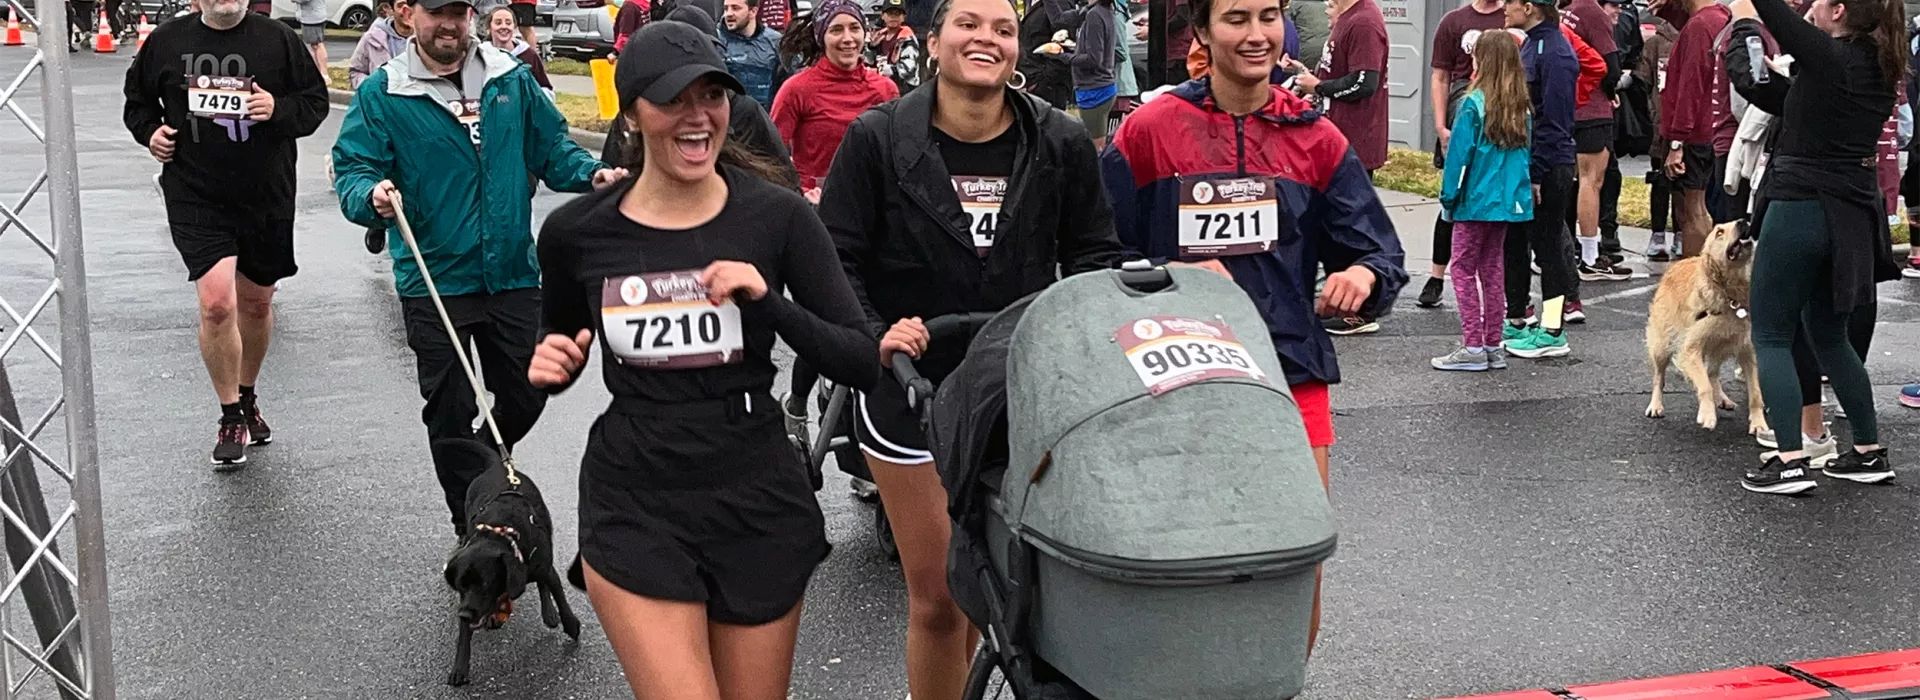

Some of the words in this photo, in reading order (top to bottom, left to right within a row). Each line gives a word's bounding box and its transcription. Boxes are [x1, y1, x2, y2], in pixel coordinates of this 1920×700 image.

[181, 53, 246, 76] 100
[198, 94, 241, 111] 7479
[961, 178, 996, 196] Turkey
[1217, 180, 1249, 198] Turkey
[1248, 180, 1266, 196] Trot
[1195, 210, 1260, 240] 7211
[625, 311, 721, 350] 7210
[1142, 342, 1250, 376] 90335
[1780, 468, 1804, 479] HOKA
